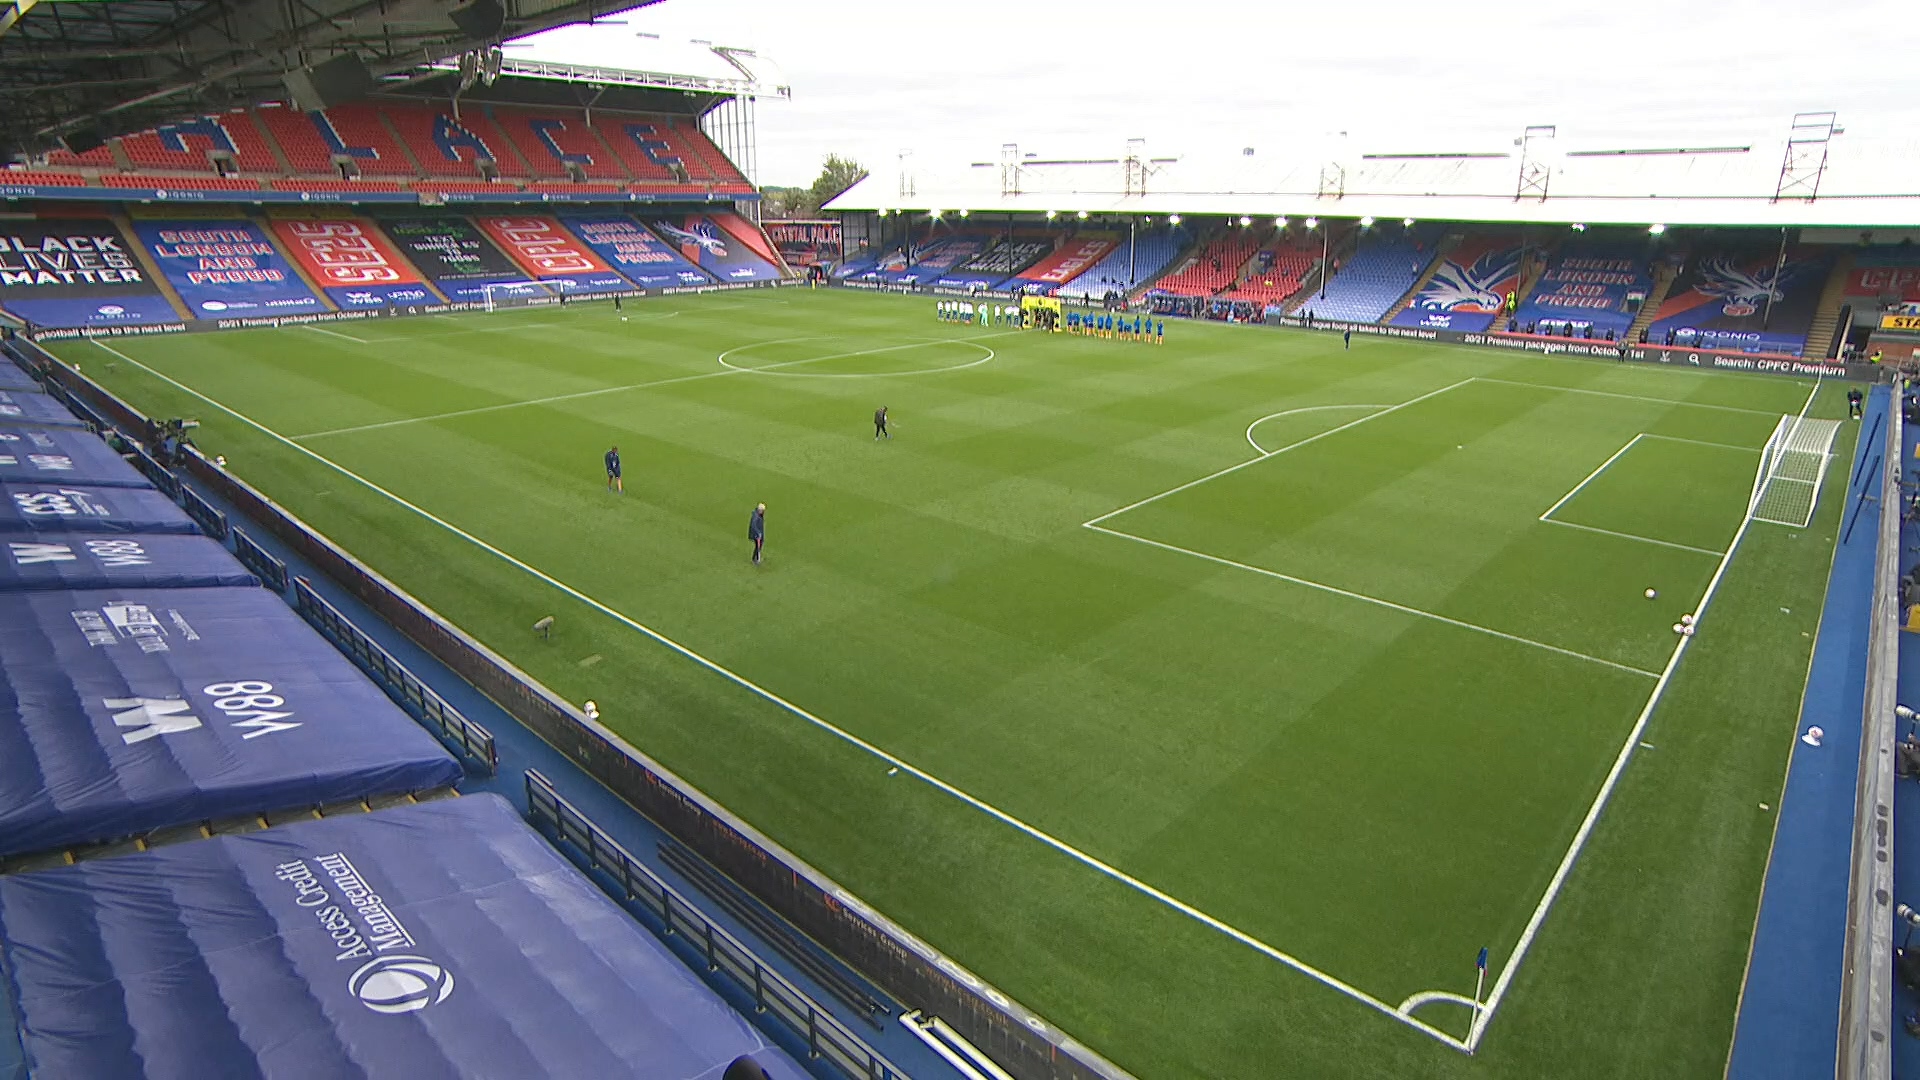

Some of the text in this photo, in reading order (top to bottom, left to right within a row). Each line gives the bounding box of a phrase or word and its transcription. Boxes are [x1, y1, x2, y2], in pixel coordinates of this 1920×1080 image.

[159, 230, 251, 243] SOUTH
[155, 242, 274, 257] LONDON
[0, 253, 133, 269] LIVES
[199, 257, 257, 270] AND
[0, 270, 142, 285] MATTER
[187, 269, 285, 284] PROUD
[1543, 269, 1636, 285] LONDON
[1556, 283, 1607, 296] AND
[1535, 294, 1612, 308] PROUD
[280, 314, 317, 325] packages
[318, 312, 337, 321] from
[337, 311, 366, 319] October
[111, 327, 122, 335] to
[123, 325, 140, 335] the
[142, 324, 162, 334] next
[163, 323, 186, 333] level
[1401, 329, 1417, 338] next
[1418, 330, 1437, 340] level
[1464, 334, 1485, 344] 20/21
[1487, 337, 1523, 348] Premium
[1525, 340, 1566, 353] packages
[1568, 344, 1589, 353] from
[1631, 350, 1644, 359] 1st
[1714, 356, 1846, 377] Search: CPFC Premium
[203, 680, 304, 740] W88
[313, 852, 414, 951] Management
[274, 859, 373, 961] Access Credit
[843, 907, 877, 937] Services
[880, 933, 908, 960] Group
